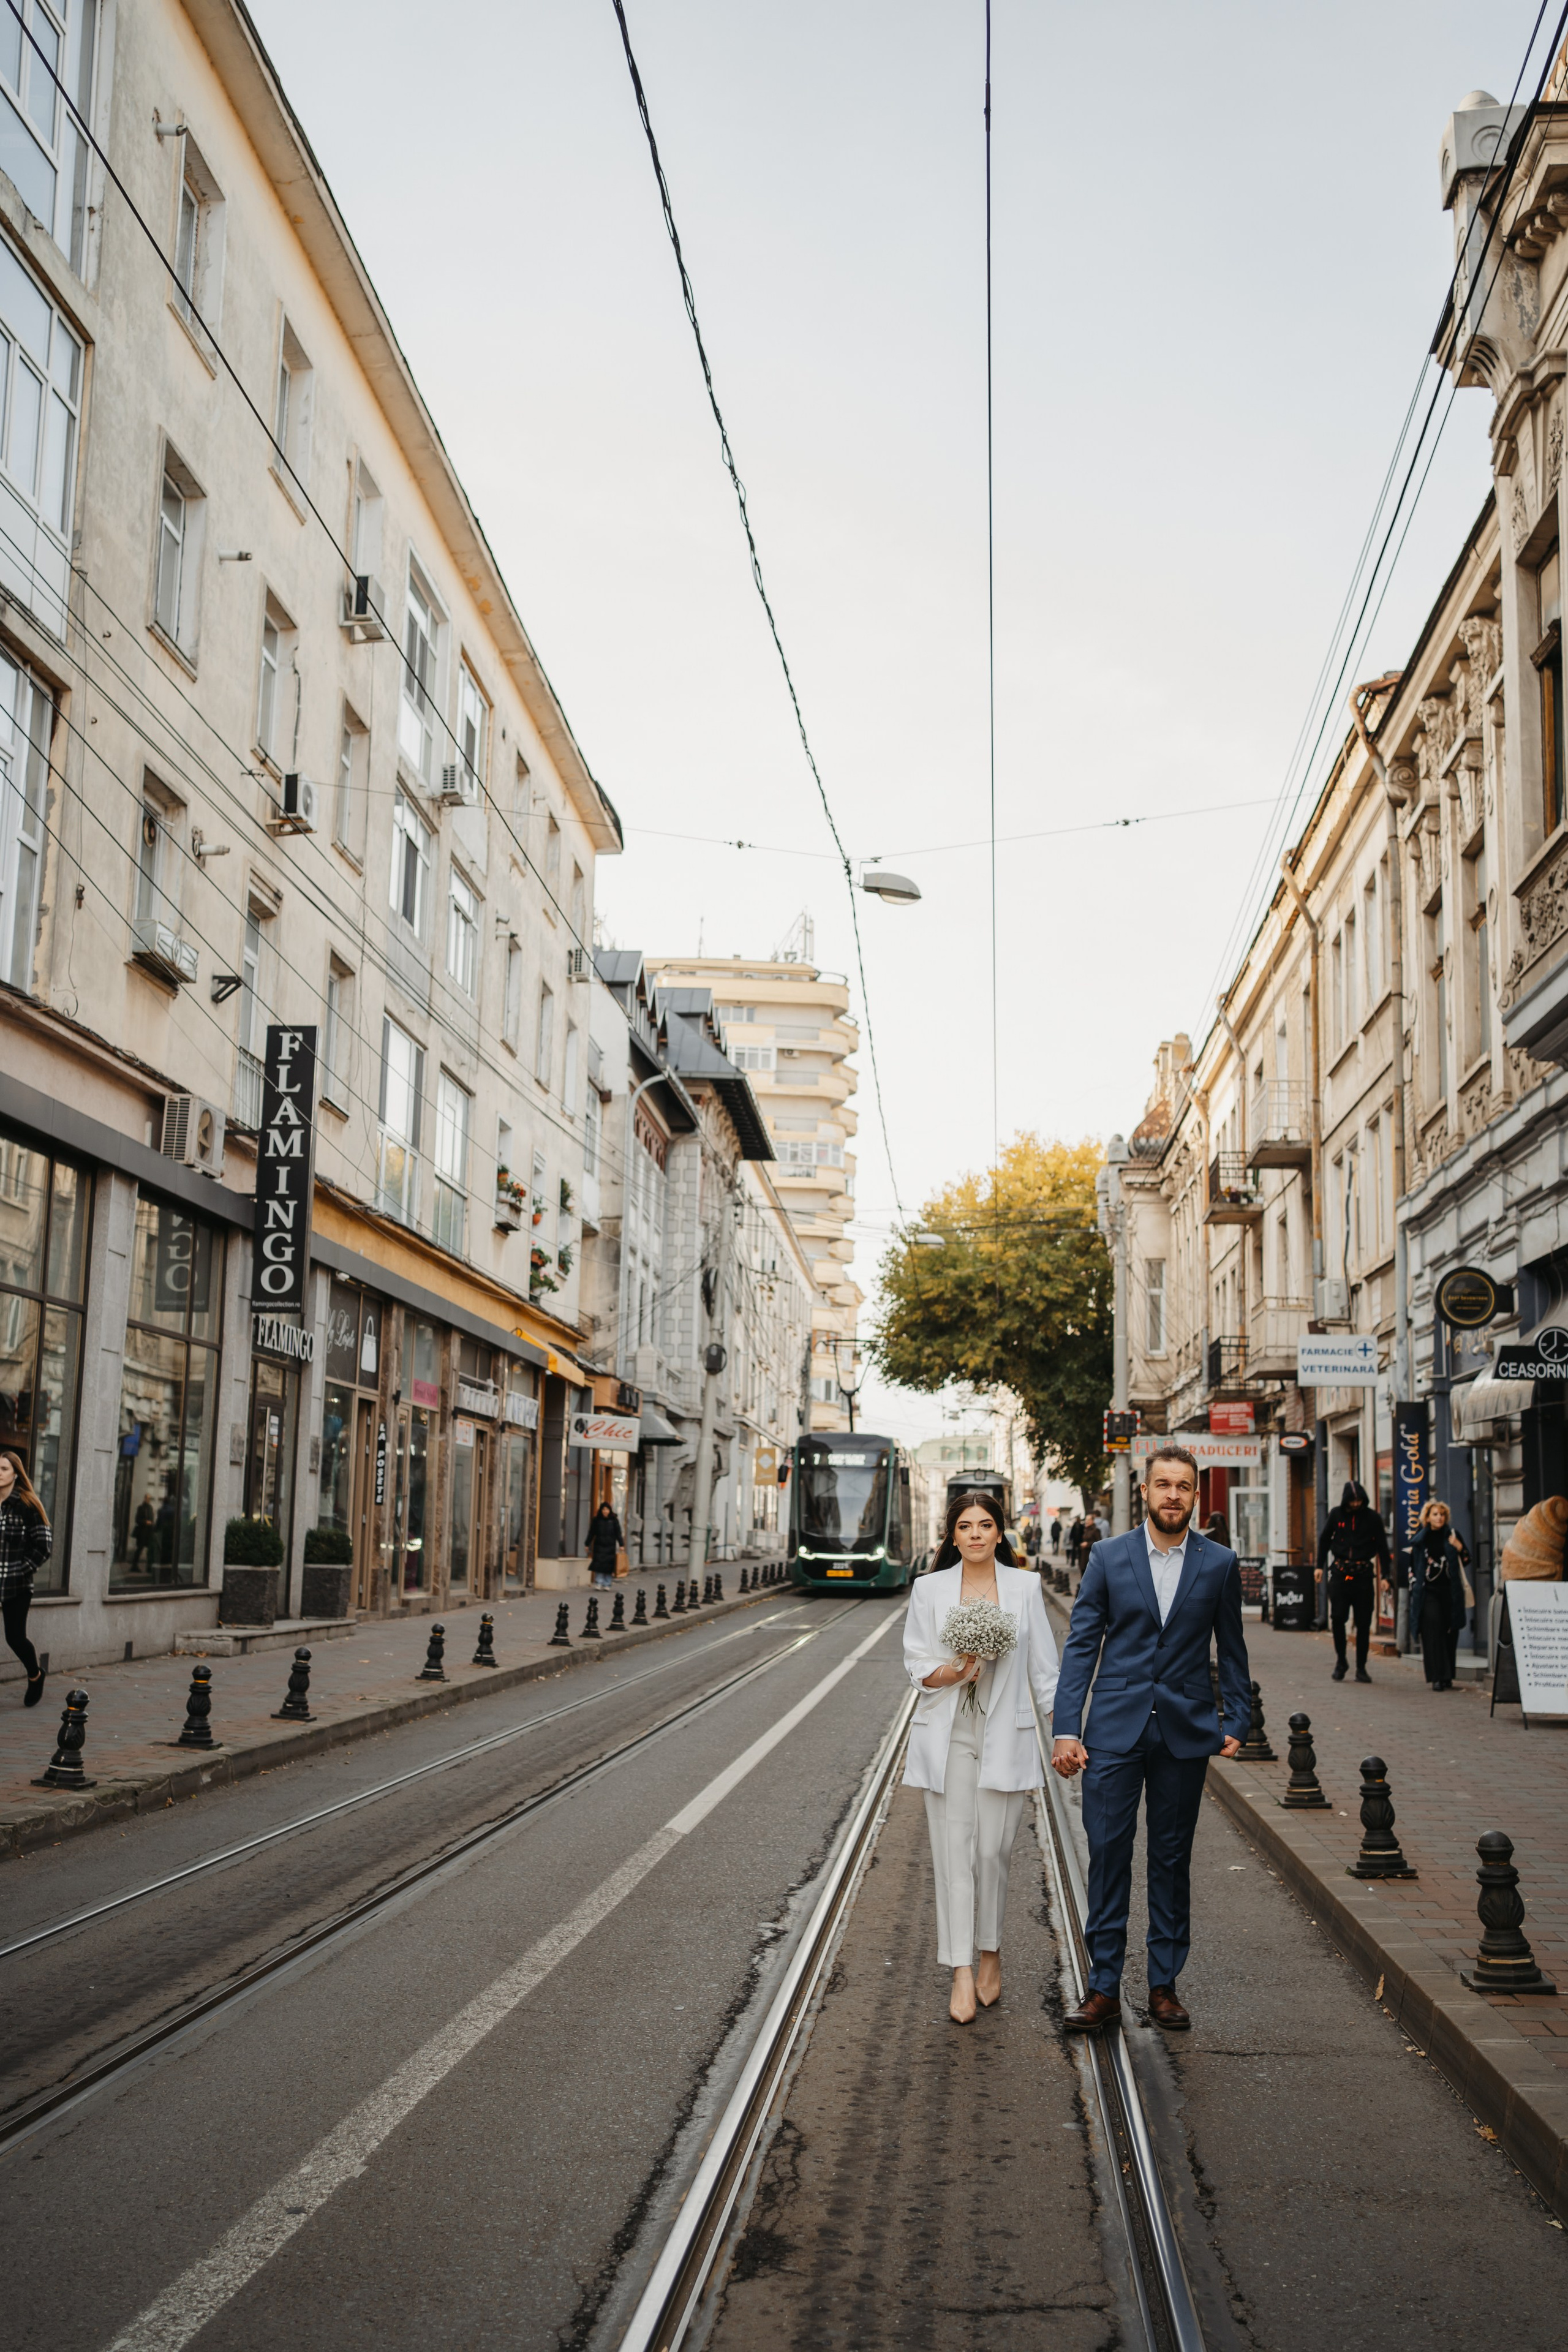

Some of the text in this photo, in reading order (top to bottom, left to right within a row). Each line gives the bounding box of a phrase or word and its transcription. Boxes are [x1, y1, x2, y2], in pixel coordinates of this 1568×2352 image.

[260, 1031, 304, 1294] FLAMINGO
[257, 1316, 315, 1362] FLAMINGO
[376, 1423, 386, 1503] LA POSETE
[584, 1420, 633, 1439] Chic
[1400, 1430, 1424, 1555] toria Gold
